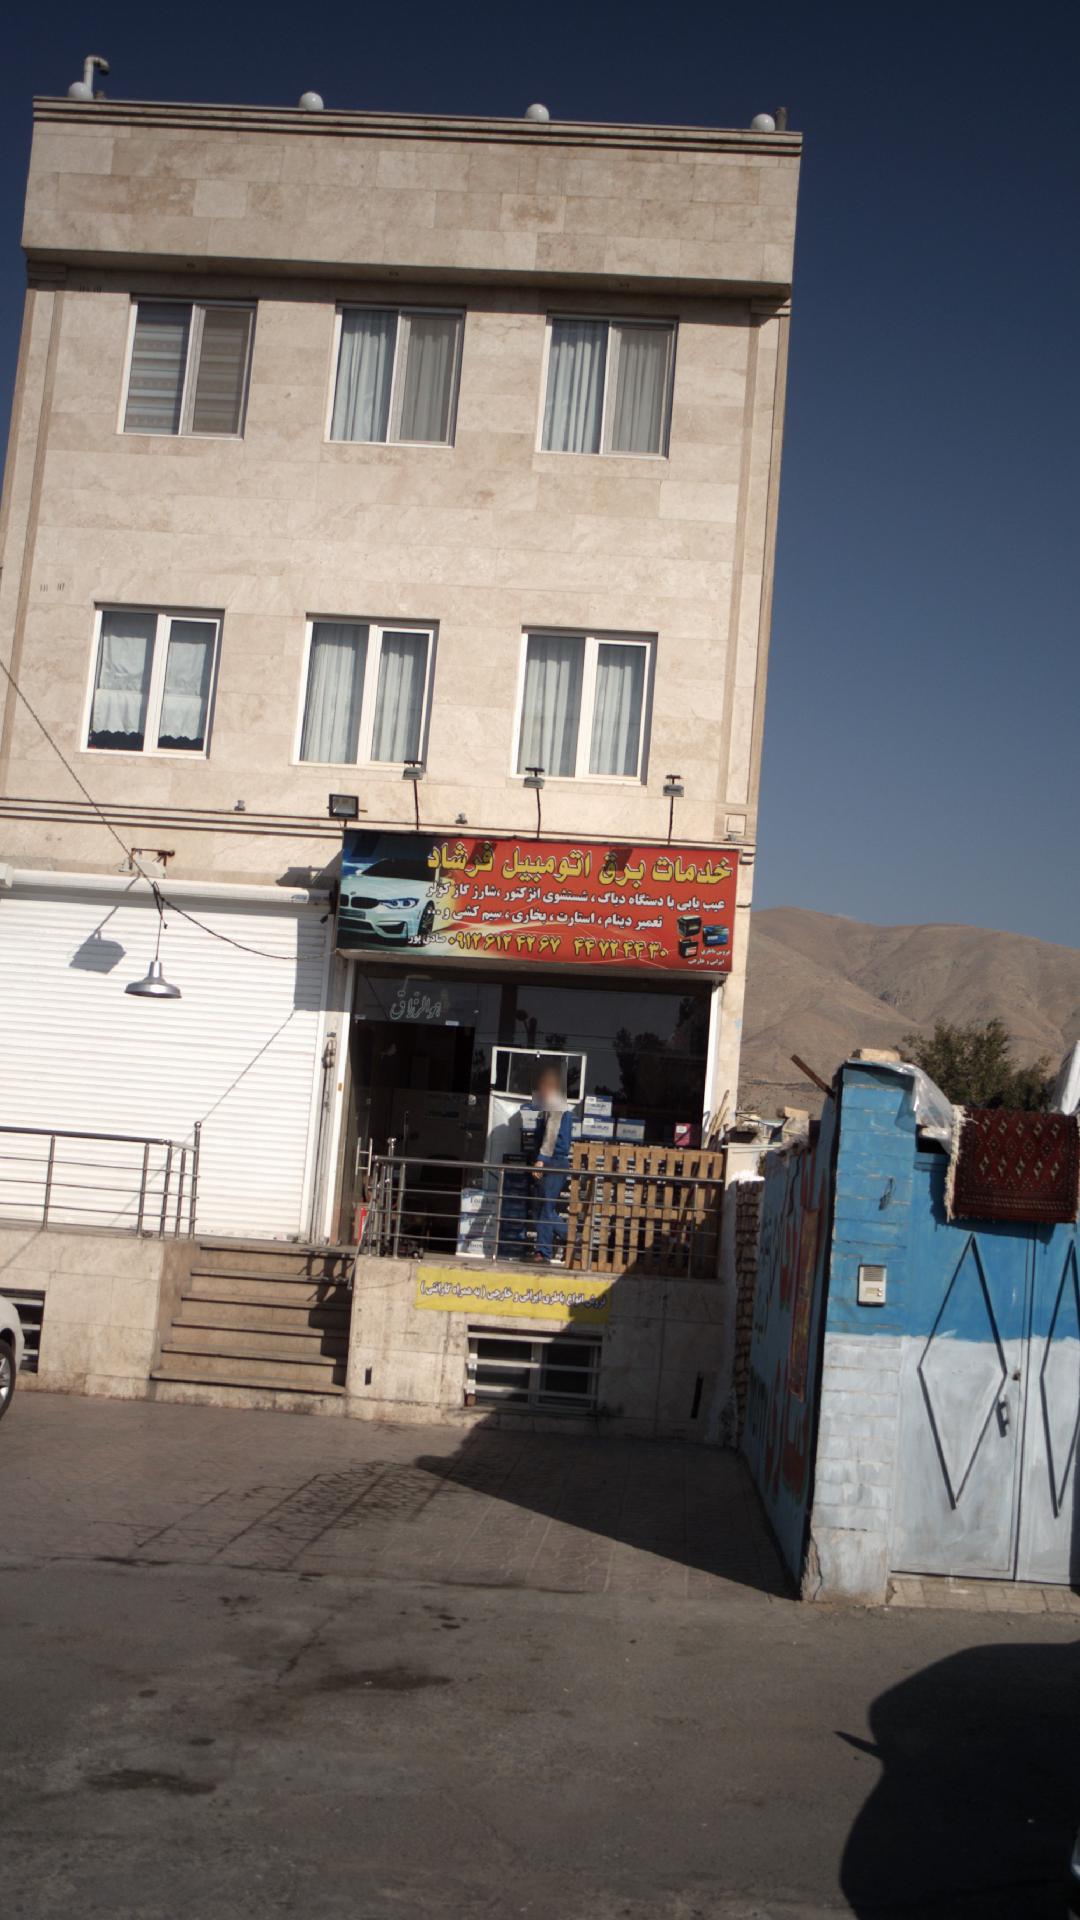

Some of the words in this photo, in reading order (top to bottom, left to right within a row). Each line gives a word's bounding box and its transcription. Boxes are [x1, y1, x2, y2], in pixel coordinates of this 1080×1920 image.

[427, 841, 495, 878] فرشاد
[502, 846, 592, 882] اتومبیل
[598, 852, 647, 889] برق
[652, 856, 733, 885] خدمات
[426, 881, 451, 898] کولر
[542, 889, 588, 904] شستشوی
[628, 893, 664, 906] دستگاه
[667, 895, 675, 910] با
[677, 897, 700, 911] یابی
[703, 900, 725, 912] عیب
[442, 907, 450, 919] و
[452, 905, 480, 919] کشی
[482, 911, 502, 921] سیم
[511, 908, 547, 925] بخاری
[556, 912, 595, 927] استارت
[604, 913, 632, 928] دینام
[635, 915, 663, 930] تعمیر
[487, 1286, 512, 1301] خارجی
[519, 1288, 542, 1304] ایرانی
